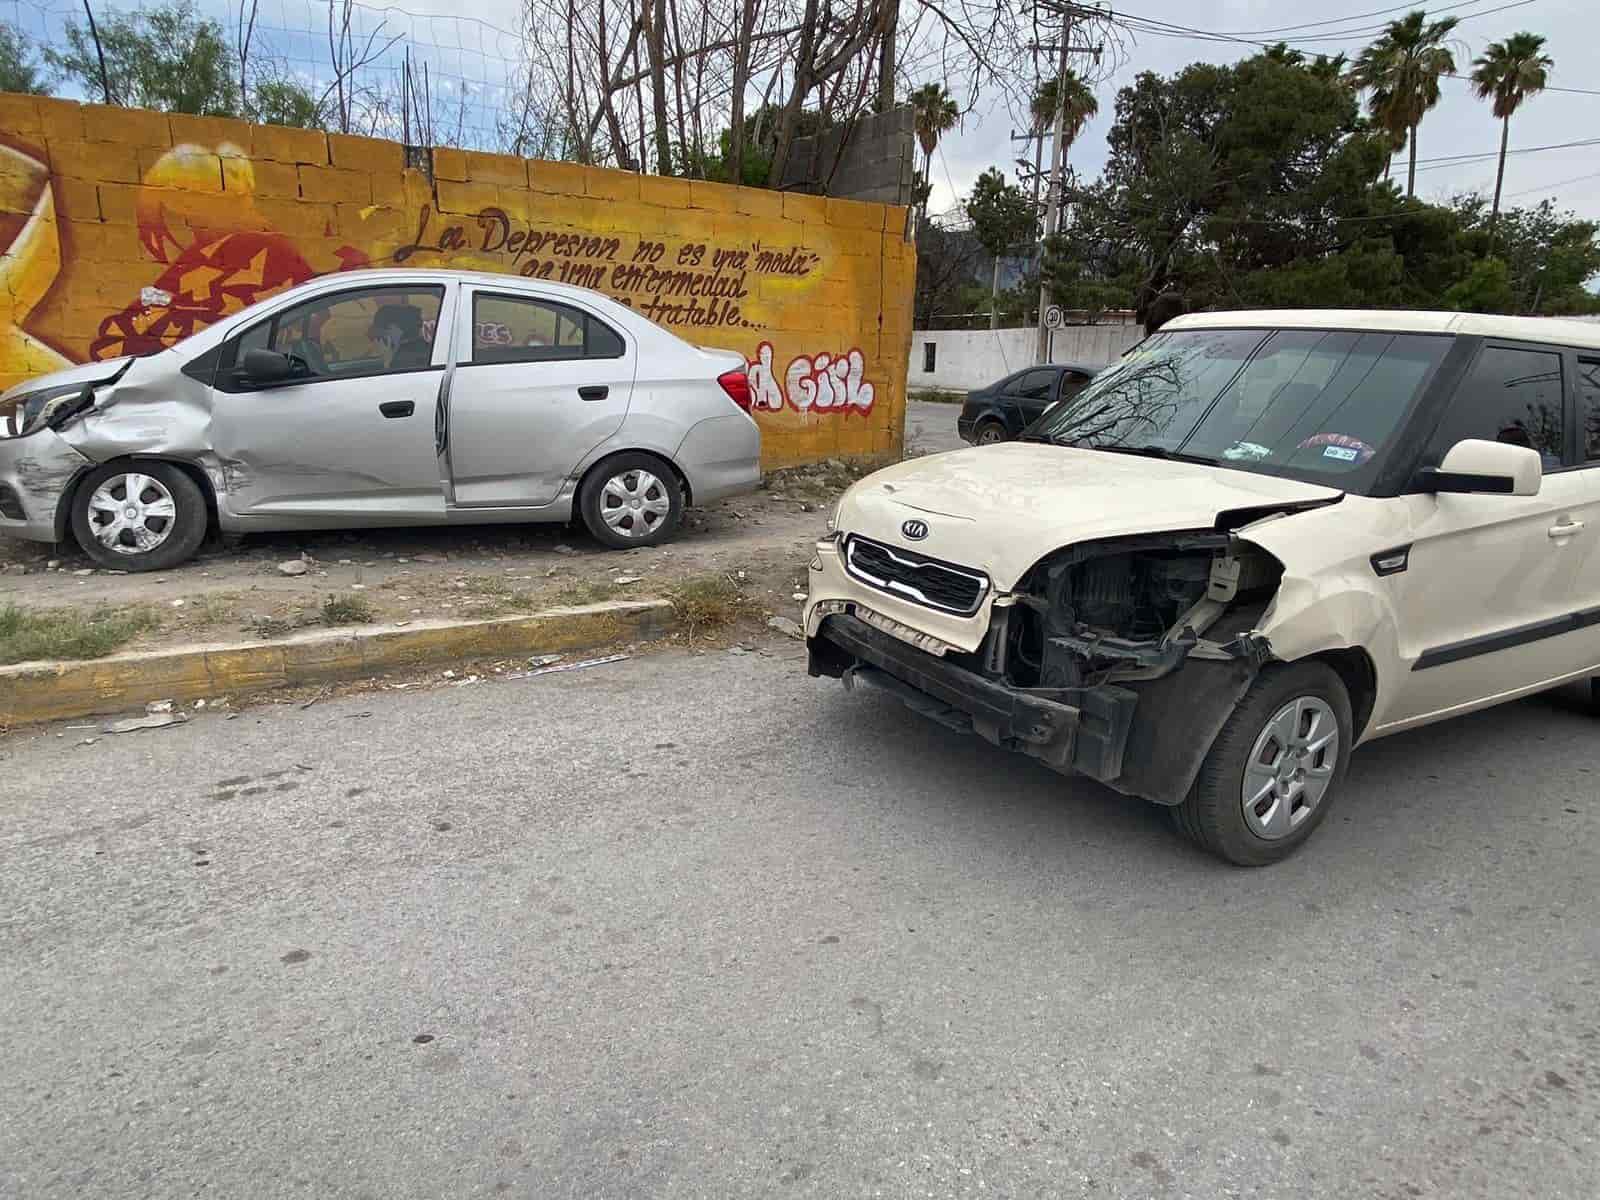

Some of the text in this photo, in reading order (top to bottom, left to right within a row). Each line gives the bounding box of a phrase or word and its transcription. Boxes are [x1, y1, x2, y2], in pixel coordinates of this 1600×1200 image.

[393, 204, 466, 262] La
[632, 240, 666, 263] no
[676, 243, 706, 266] es
[712, 247, 749, 270] una
[560, 260, 607, 289] una
[903, 521, 927, 538] KIA
